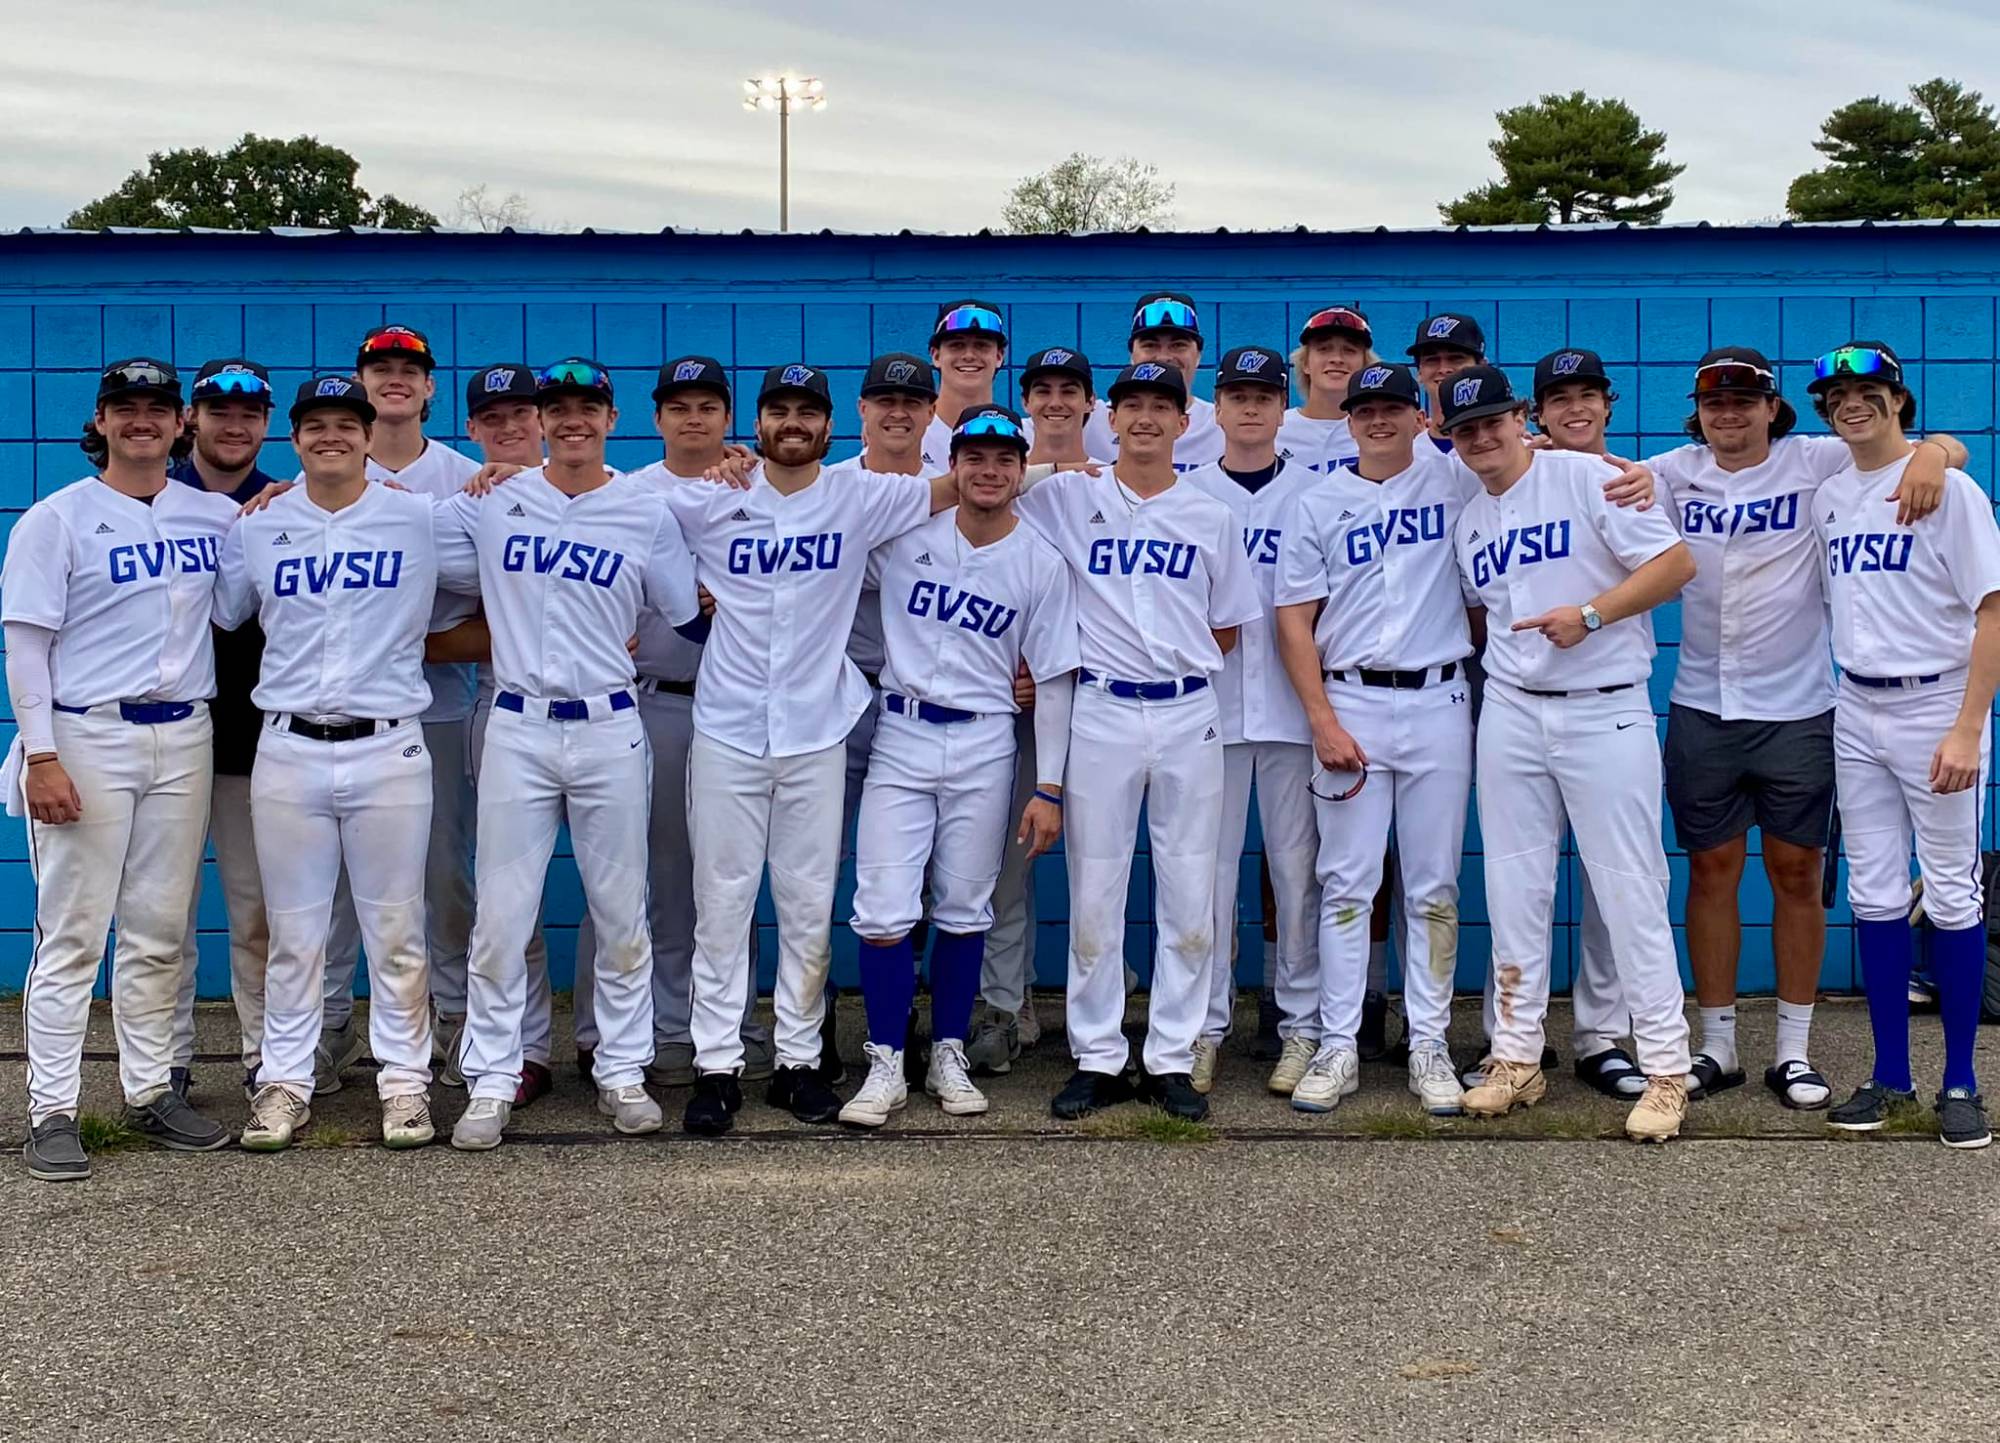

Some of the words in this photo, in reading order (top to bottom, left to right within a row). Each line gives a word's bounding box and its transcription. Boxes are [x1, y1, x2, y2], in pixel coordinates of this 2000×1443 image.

[485, 368, 516, 392] GV
[674, 360, 706, 382] GV
[1132, 363, 1167, 382] GV
[1235, 350, 1269, 373] GV
[1360, 366, 1393, 388] GV
[1453, 378, 1483, 406] GV
[1346, 504, 1444, 565] GVSU
[1685, 493, 1798, 537] GVSU
[109, 536, 217, 584] GVSU
[274, 551, 403, 597] GVSU
[503, 535, 624, 588] GVSU
[729, 533, 842, 574] GVSU
[1088, 539, 1196, 579] GVSU
[1473, 520, 1570, 588] GVSU
[1829, 534, 1913, 576] GVSU
[908, 581, 1017, 638] GVSU
